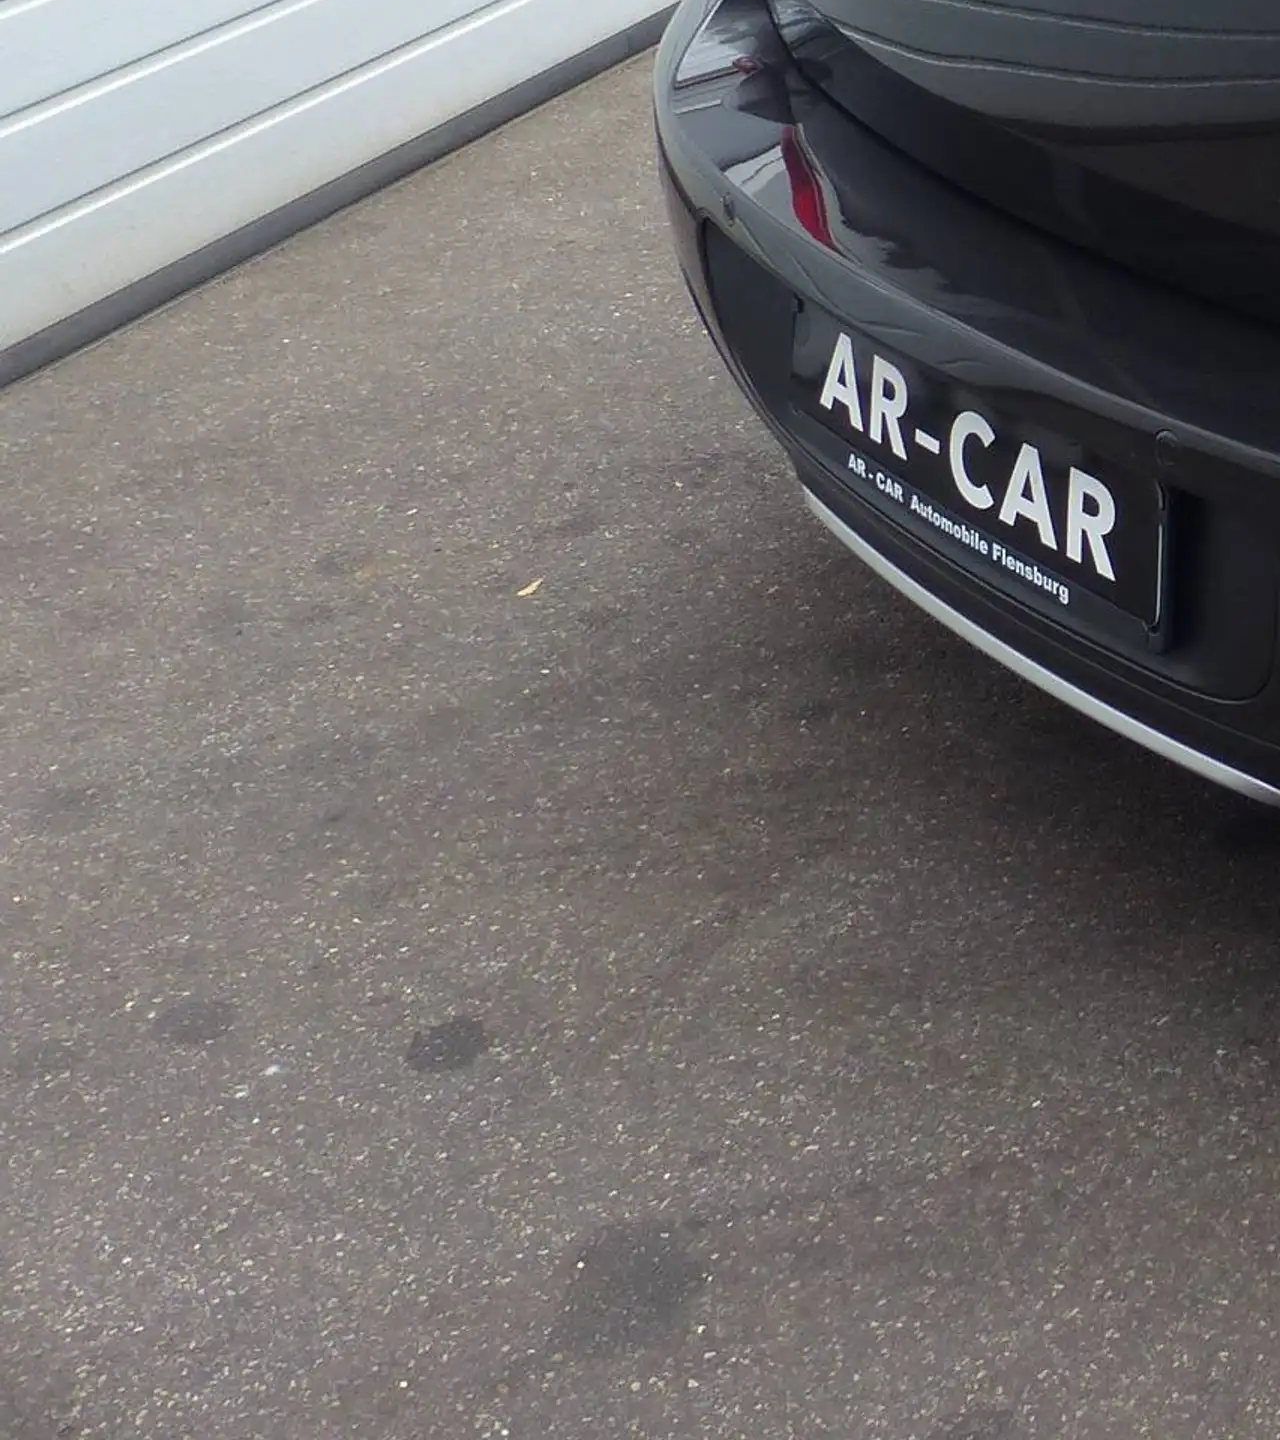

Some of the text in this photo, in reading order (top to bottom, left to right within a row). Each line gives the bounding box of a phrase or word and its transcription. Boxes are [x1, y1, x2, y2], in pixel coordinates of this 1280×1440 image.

[819, 332, 1116, 582] AR-CAR
[910, 494, 989, 555] Automobile
[992, 542, 1070, 605] Flensburg
